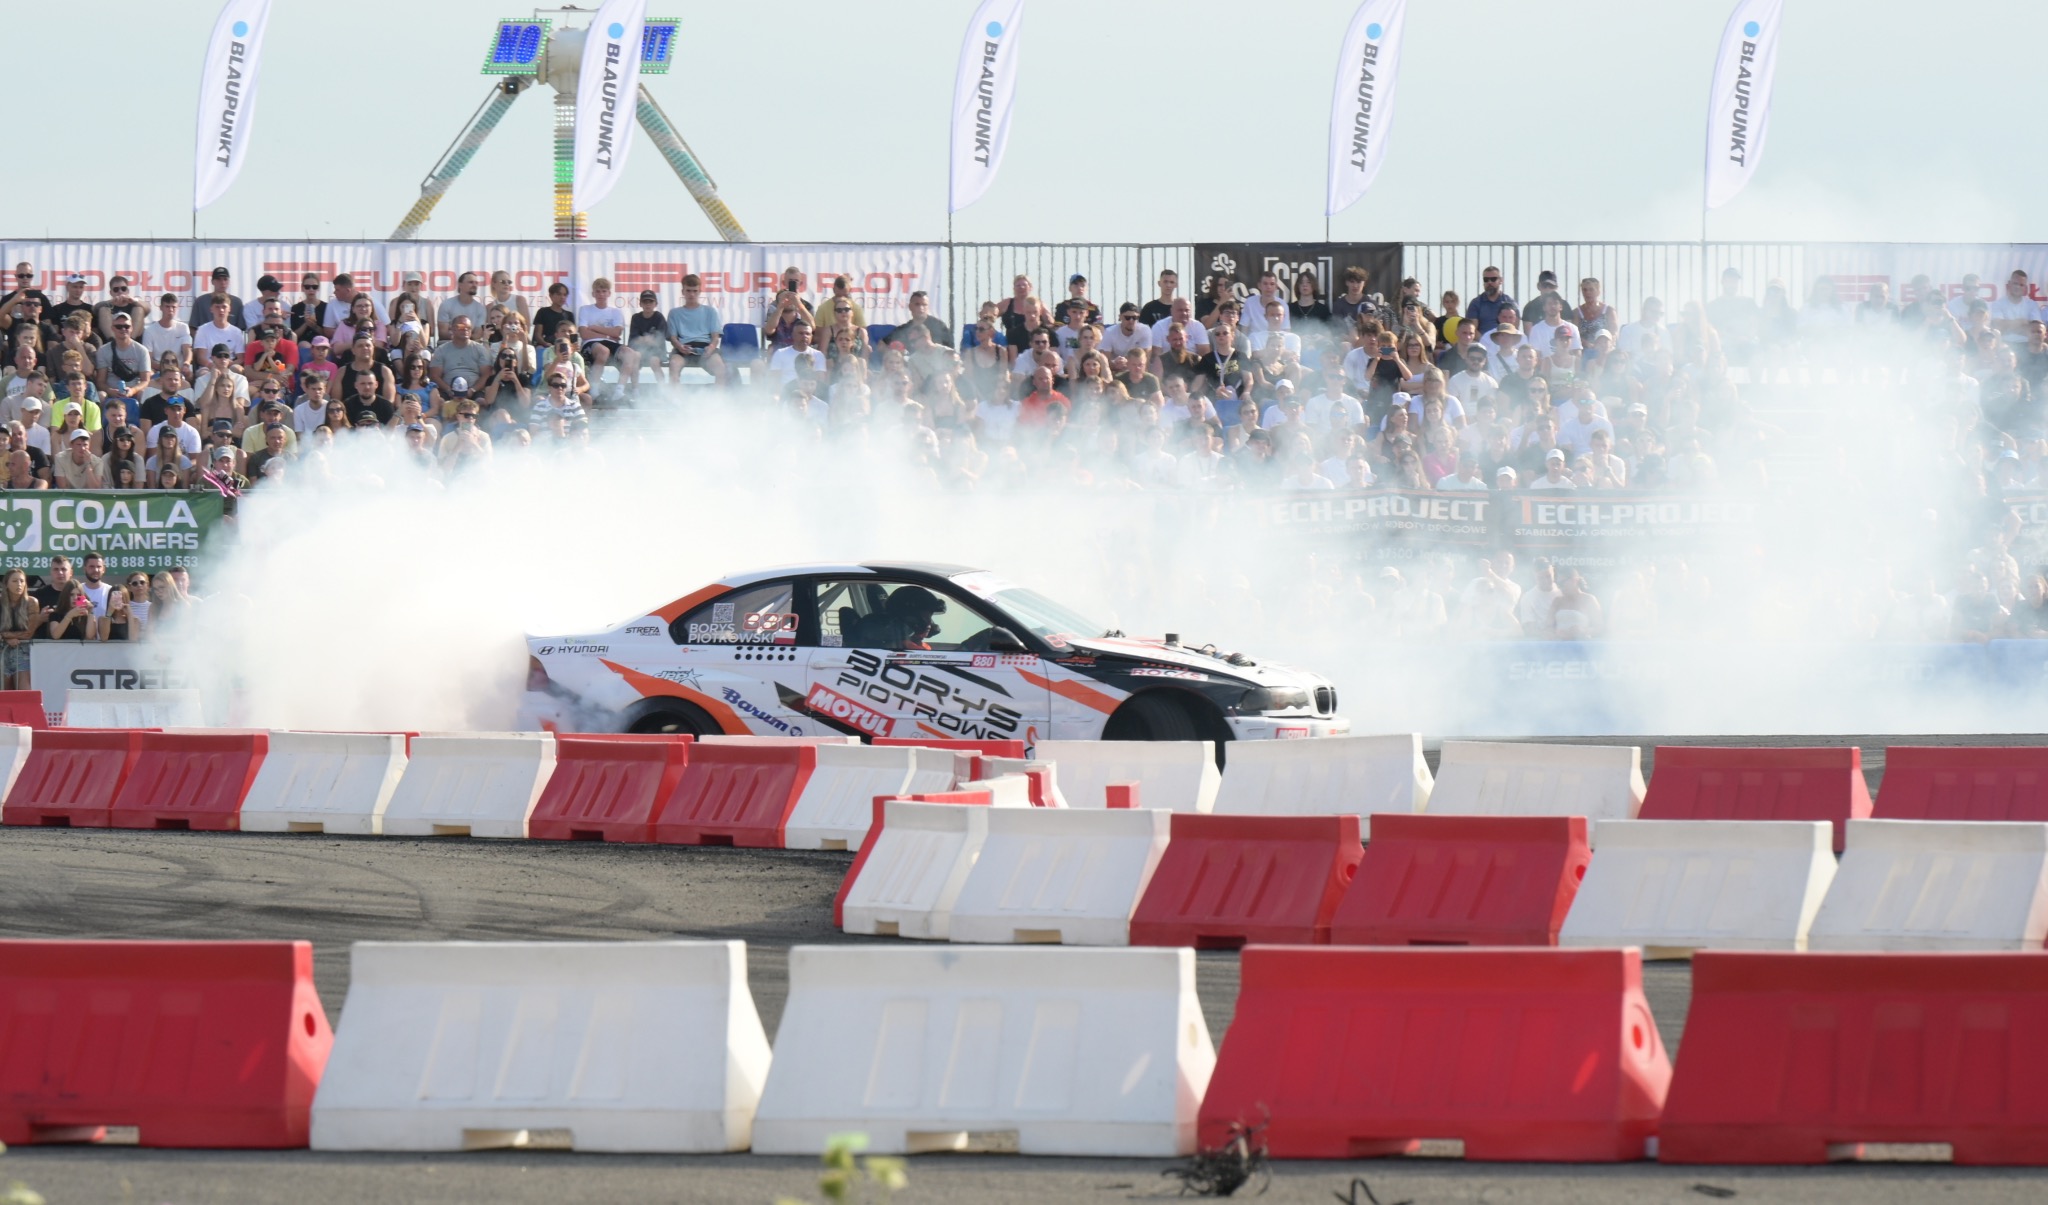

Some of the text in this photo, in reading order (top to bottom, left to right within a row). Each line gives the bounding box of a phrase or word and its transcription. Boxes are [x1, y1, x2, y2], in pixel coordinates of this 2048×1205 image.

[216, 41, 245, 168] BLAUPUNKT
[596, 42, 620, 170] BLAUPUNKT
[974, 41, 998, 168] BLAUPUNKT
[1350, 43, 1378, 172] BLAUPUNKT
[1730, 41, 1756, 168] BLAUPUNKT
[49, 500, 198, 529] COALA
[1428, 524, 1488, 535] DROGOWE
[1514, 528, 1588, 538] STABILIZACJA
[49, 533, 198, 551] CONTAINERS
[6, 557, 29, 568] 538
[33, 557, 54, 568] 28
[121, 556, 145, 567] 888
[148, 556, 171, 567] 518
[175, 556, 198, 567] 553
[625, 626, 660, 634] STREFA
[690, 623, 735, 634] BORYS
[742, 613, 799, 631] 880
[688, 632, 775, 644] PIOTROWSKI
[558, 645, 609, 654] HYUNDAI
[973, 655, 994, 667] 880
[847, 649, 1022, 733] BORYS
[722, 686, 789, 732] Barum
[809, 691, 889, 737] MOTUL
